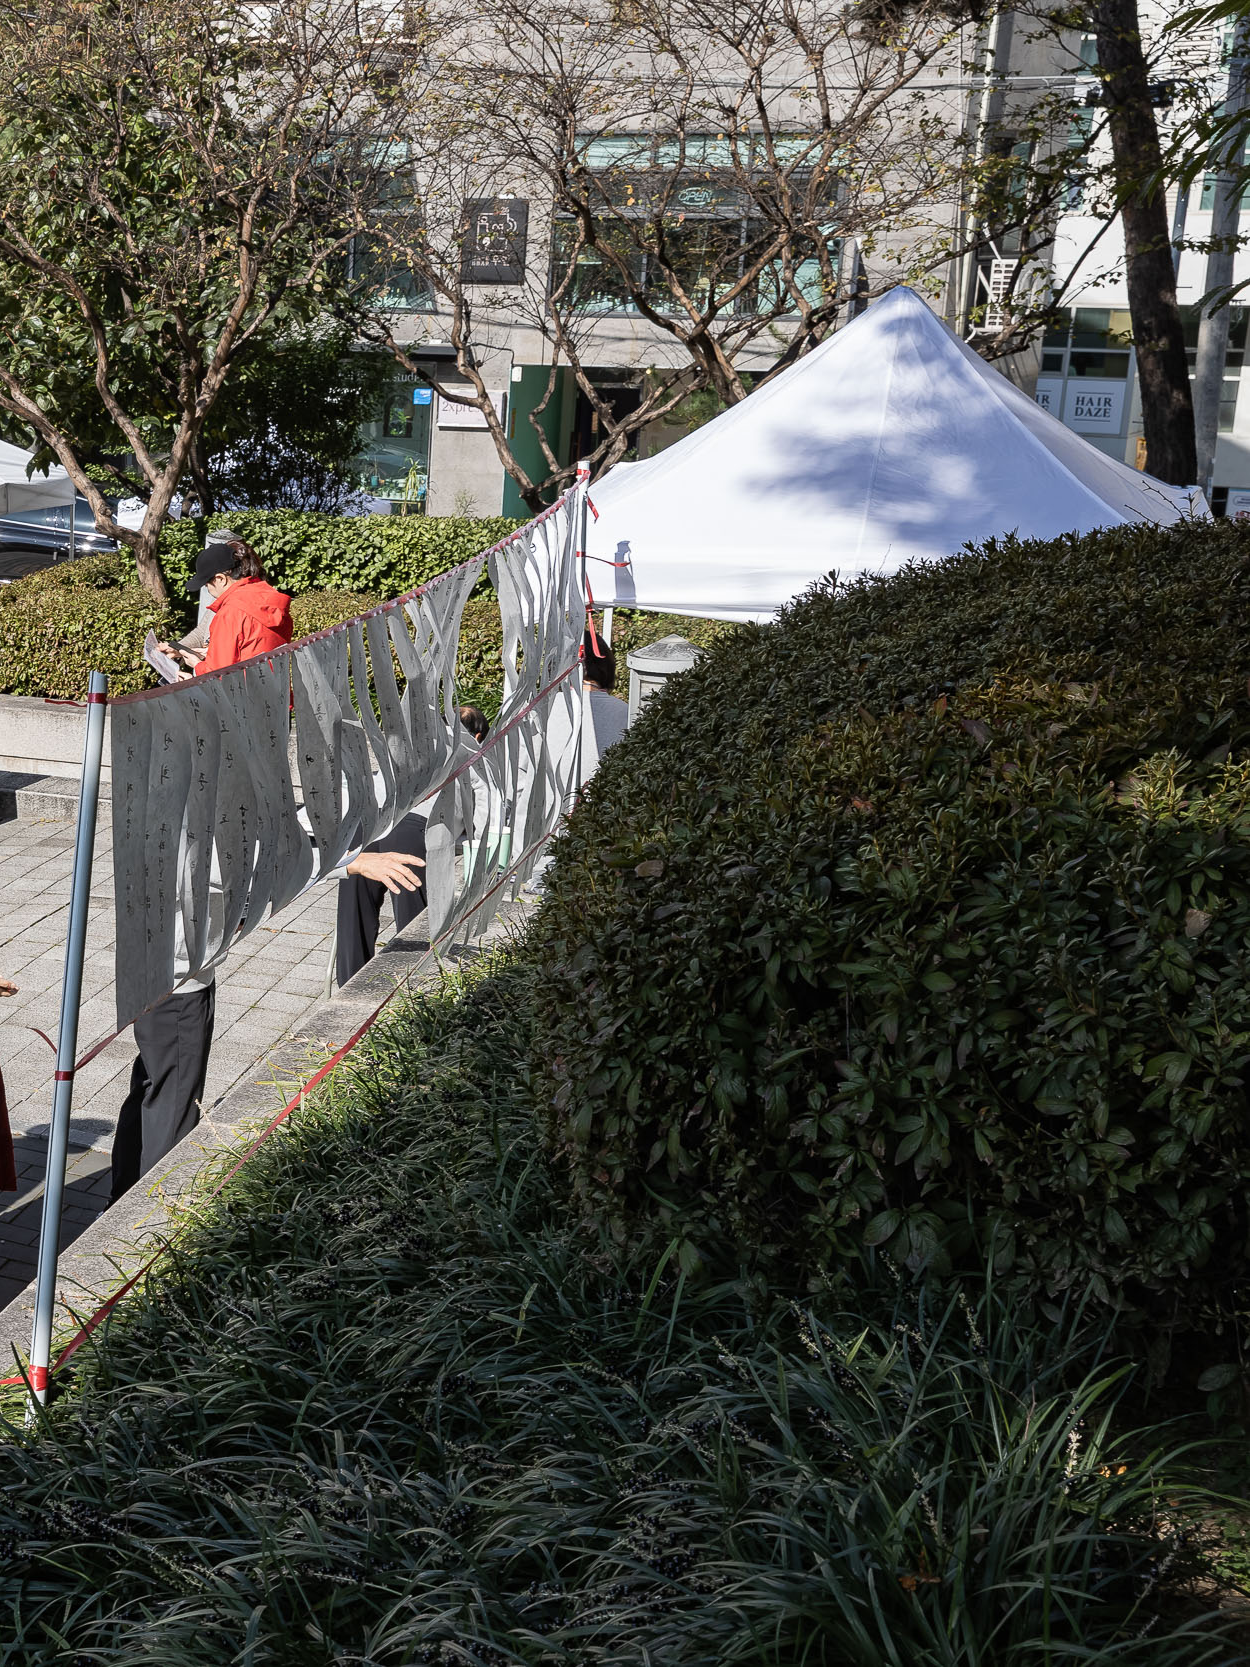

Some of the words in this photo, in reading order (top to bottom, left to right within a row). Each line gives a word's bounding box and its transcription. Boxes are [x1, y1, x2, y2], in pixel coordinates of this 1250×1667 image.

[679, 191, 711, 202] OPEN
[1076, 396, 1112, 407] HAIR
[1075, 407, 1111, 418] DAZE
